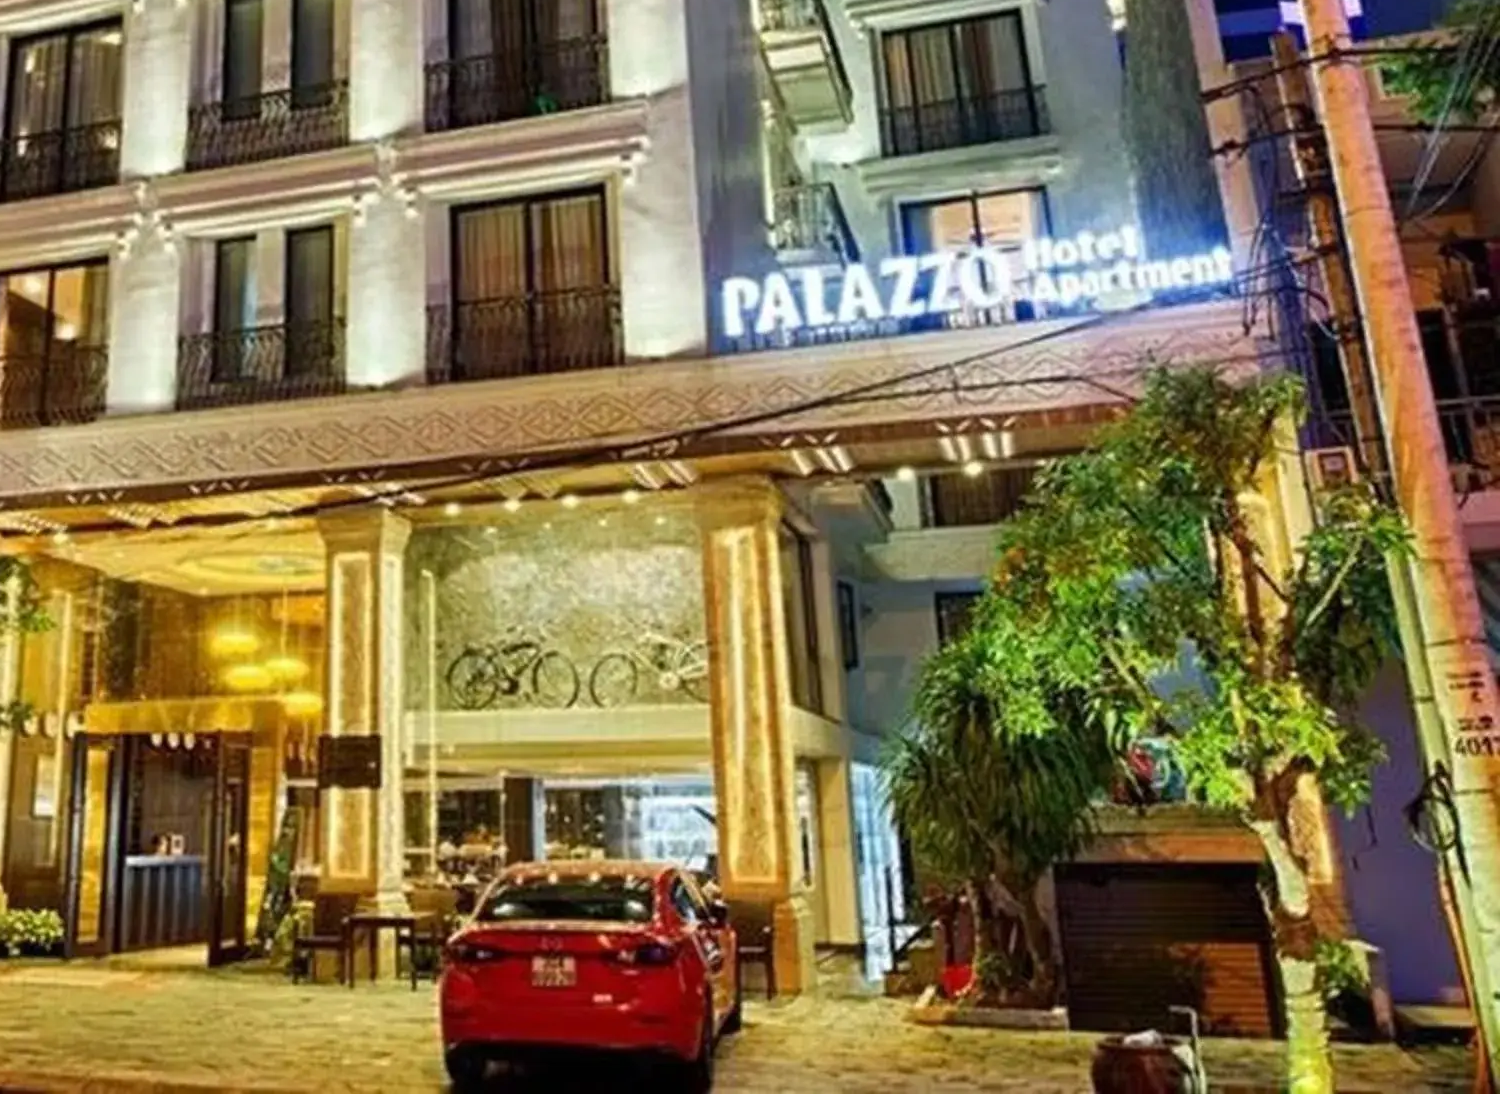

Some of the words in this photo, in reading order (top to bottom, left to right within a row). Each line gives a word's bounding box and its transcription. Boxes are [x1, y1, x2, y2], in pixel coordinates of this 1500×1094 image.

[1025, 224, 1139, 270] Hotel
[1033, 244, 1232, 306] Apartment
[721, 244, 1012, 336] PALAZZO
